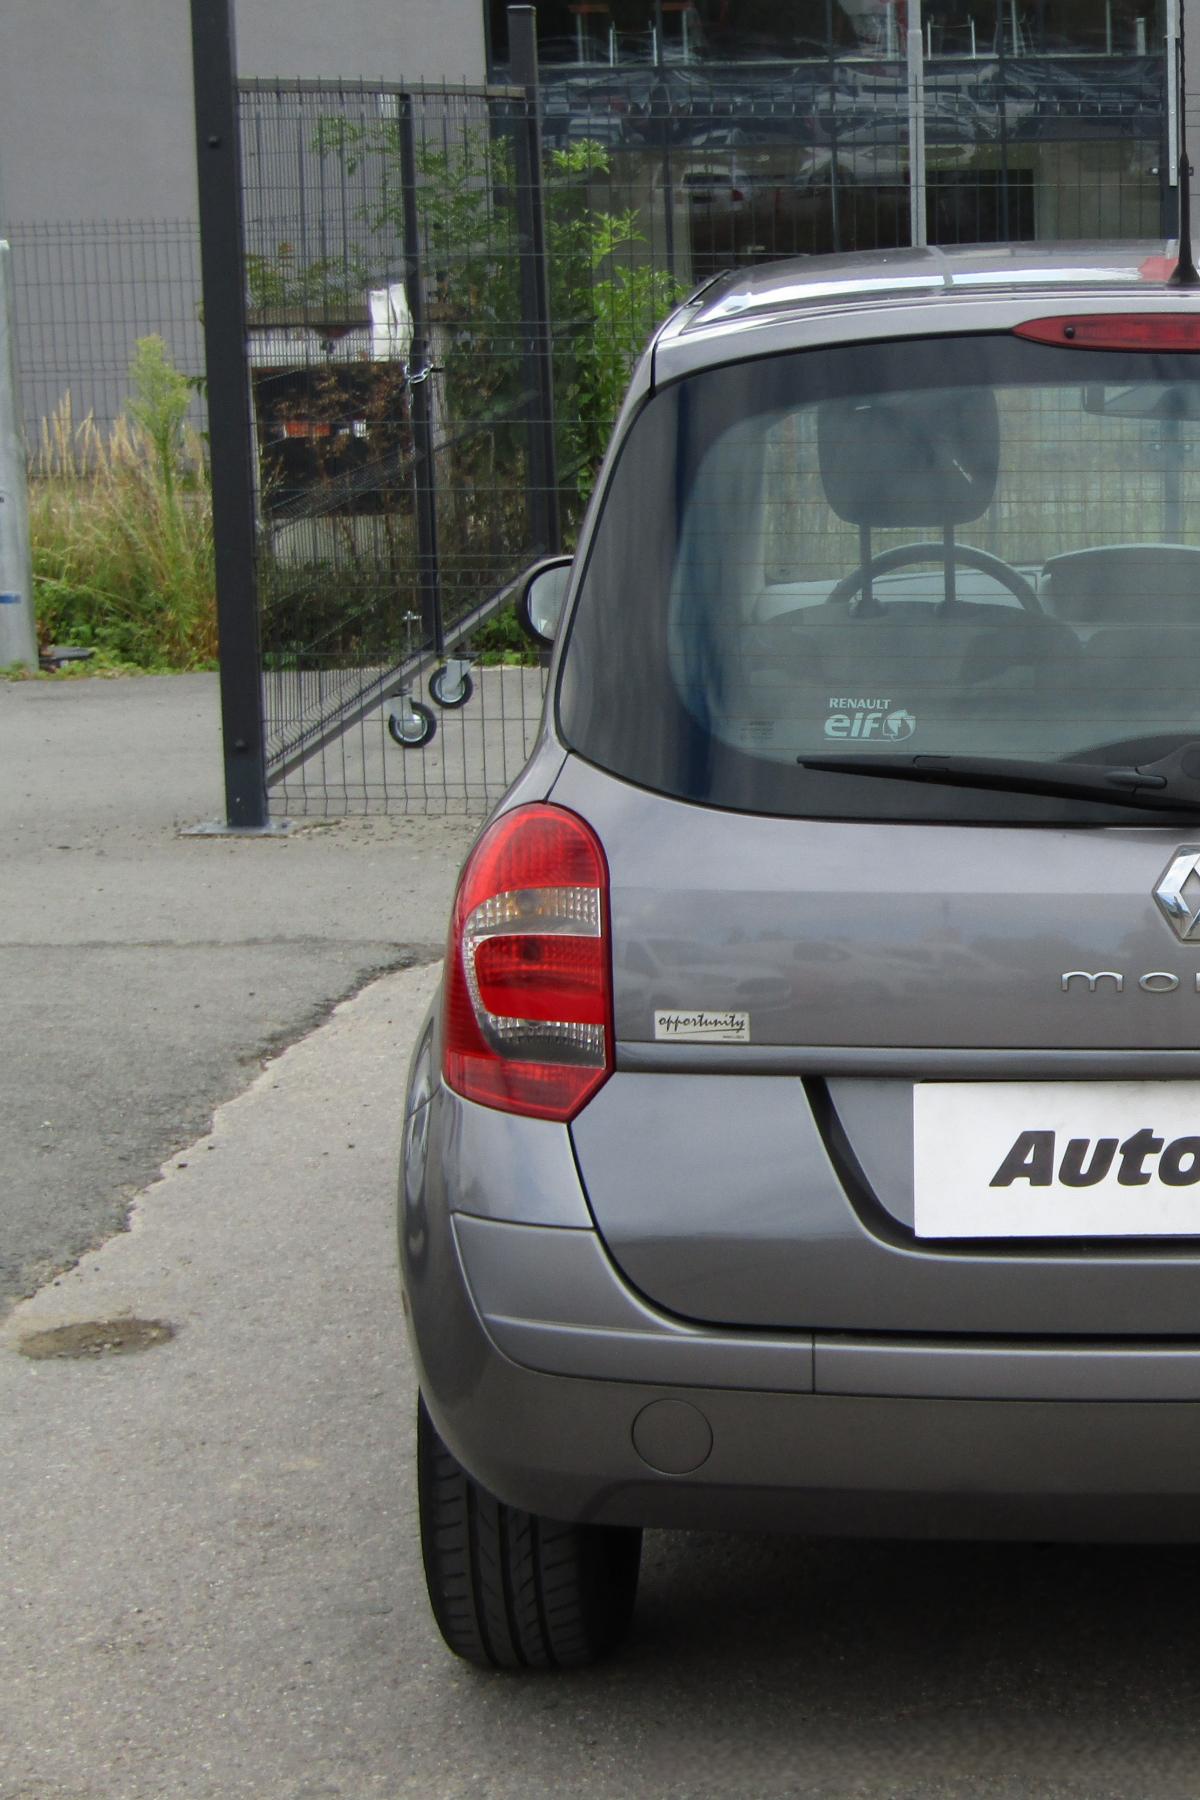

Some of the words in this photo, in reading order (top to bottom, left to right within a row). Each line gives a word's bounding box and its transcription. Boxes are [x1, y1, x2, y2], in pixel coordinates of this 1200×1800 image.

[829, 697, 892, 710] RENAULT
[824, 712, 882, 738] elf
[658, 1012, 745, 1033] opportunity
